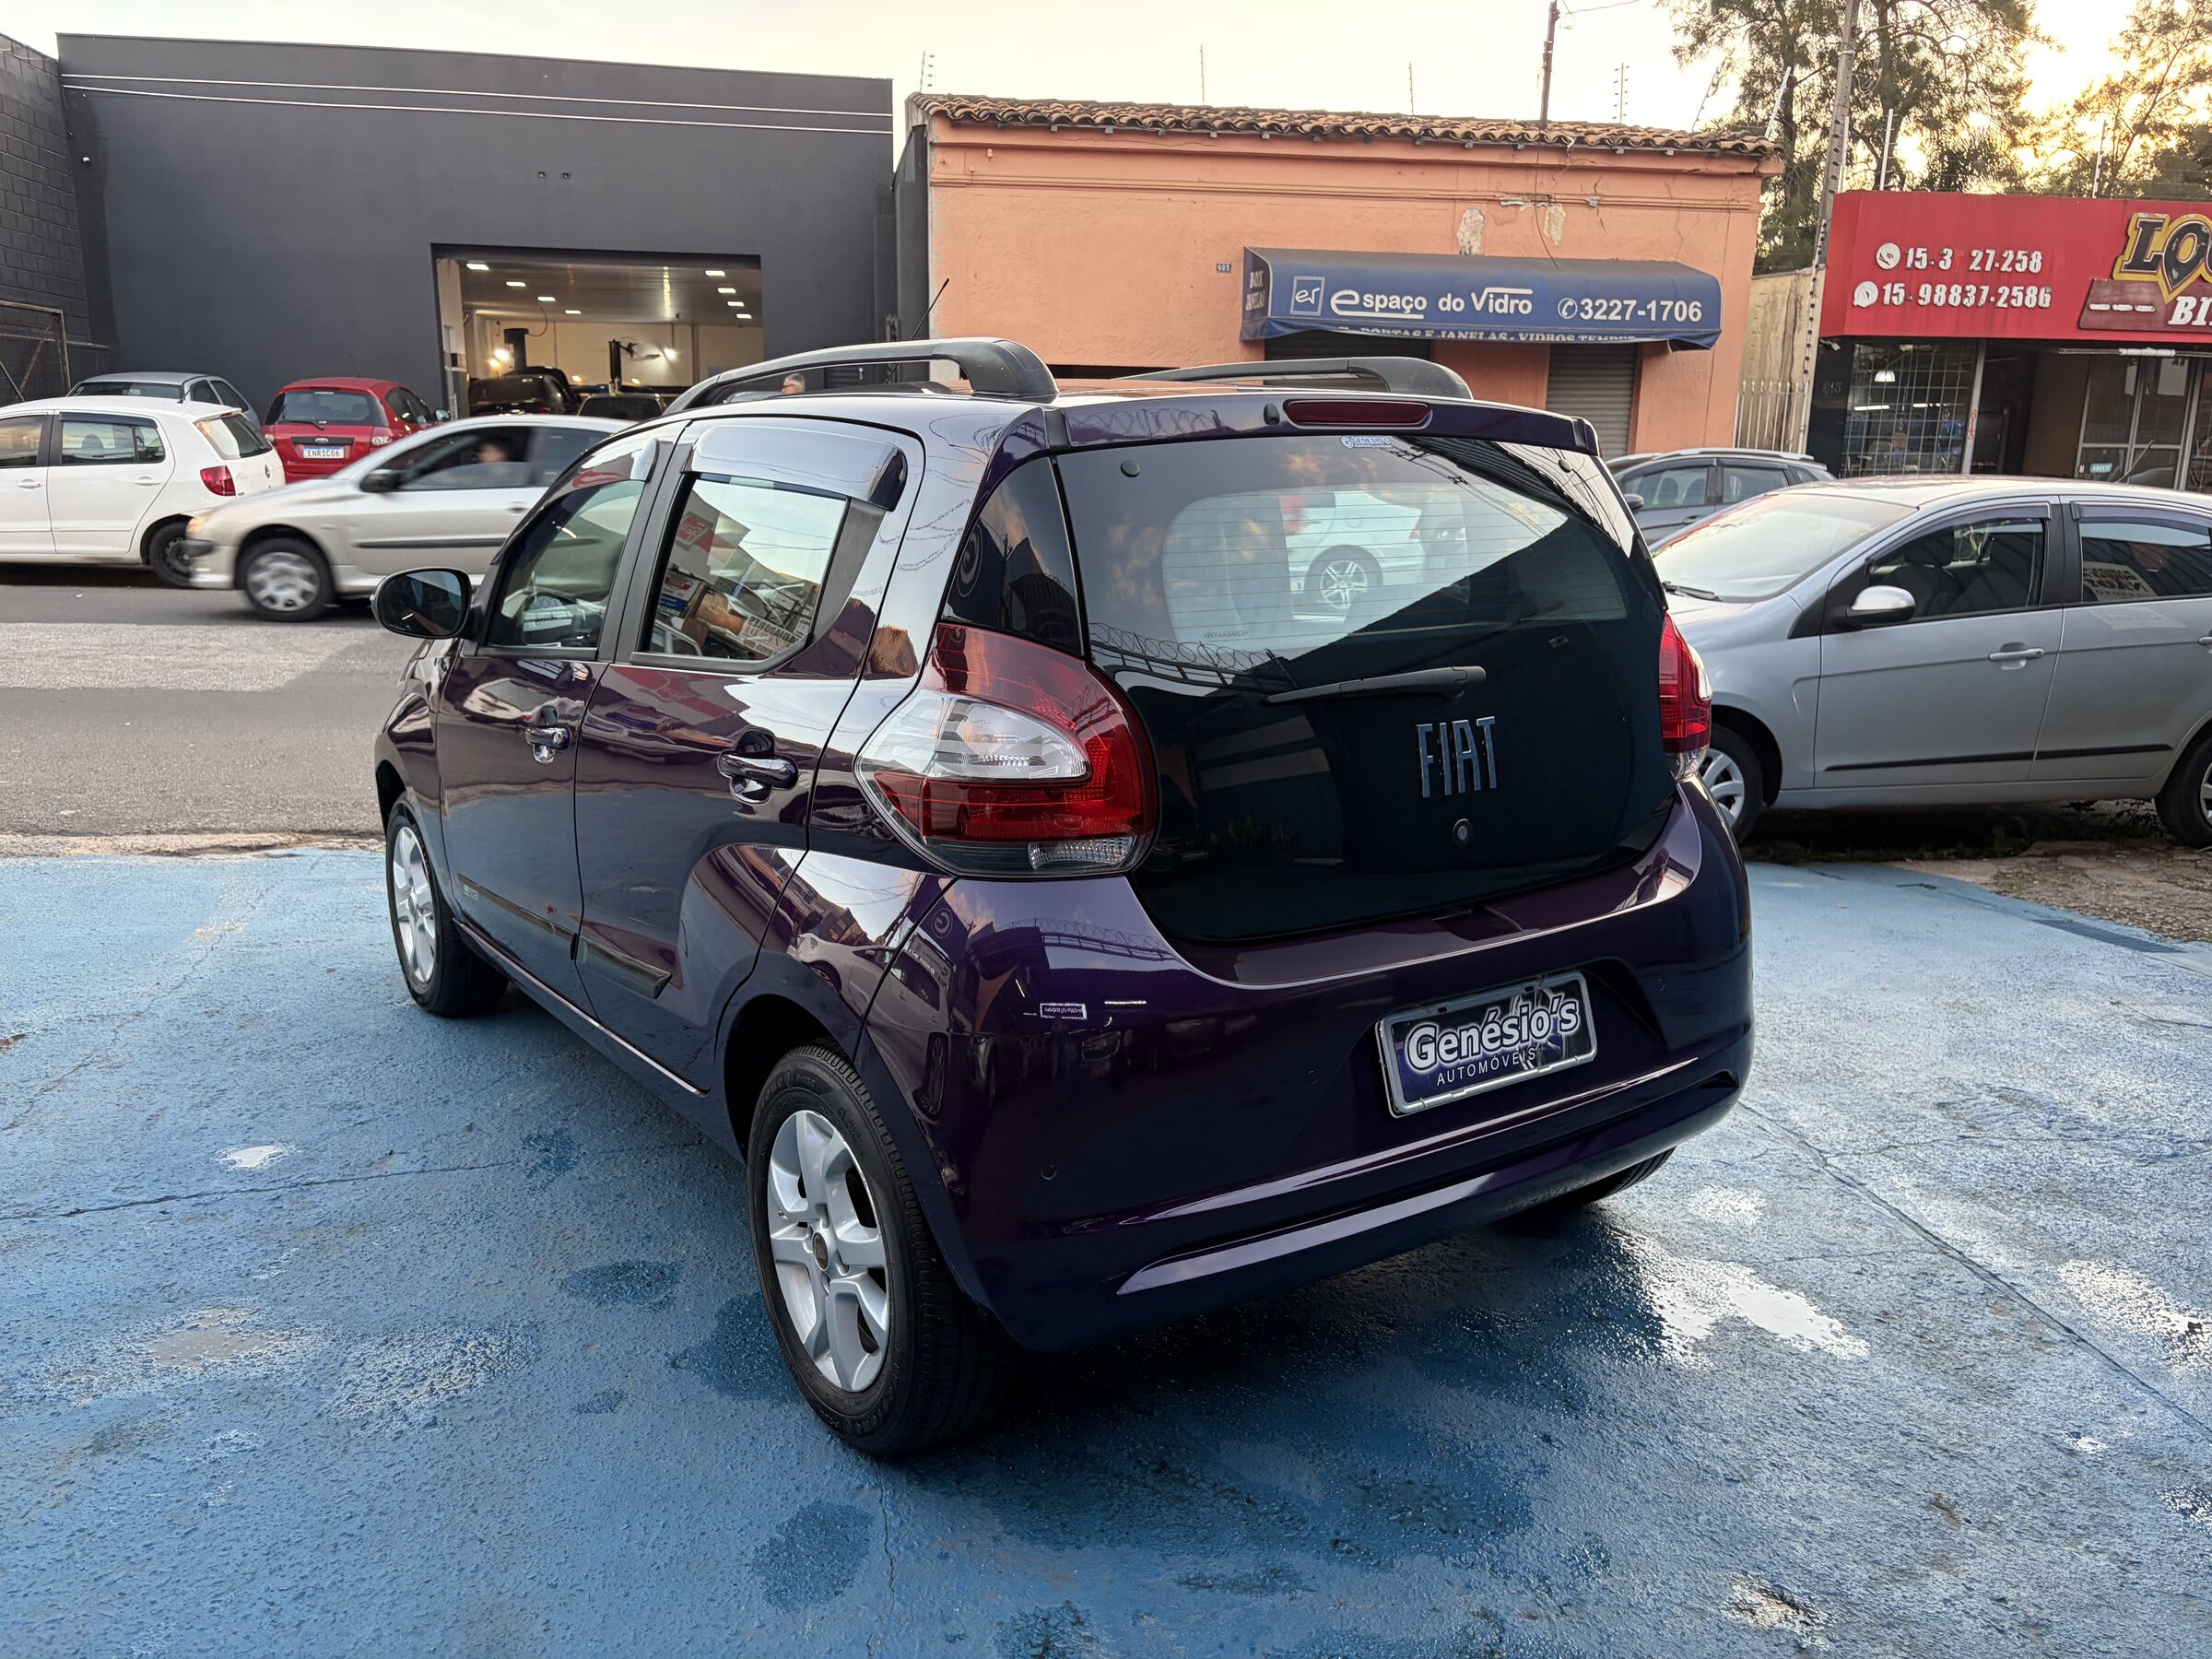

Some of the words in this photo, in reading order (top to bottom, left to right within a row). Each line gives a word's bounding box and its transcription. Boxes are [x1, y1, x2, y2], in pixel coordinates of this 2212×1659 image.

[2121, 218, 2212, 291] LO
[1438, 292, 1465, 312] do
[1471, 287, 1534, 315] Vidro
[1579, 298, 1702, 323] 3227-1706
[2167, 296, 2212, 326] BI
[1416, 716, 1497, 798] FIAT
[1406, 994, 1579, 1071] Genésio's
[1436, 1046, 1536, 1087] AUTOMÓVEIS
